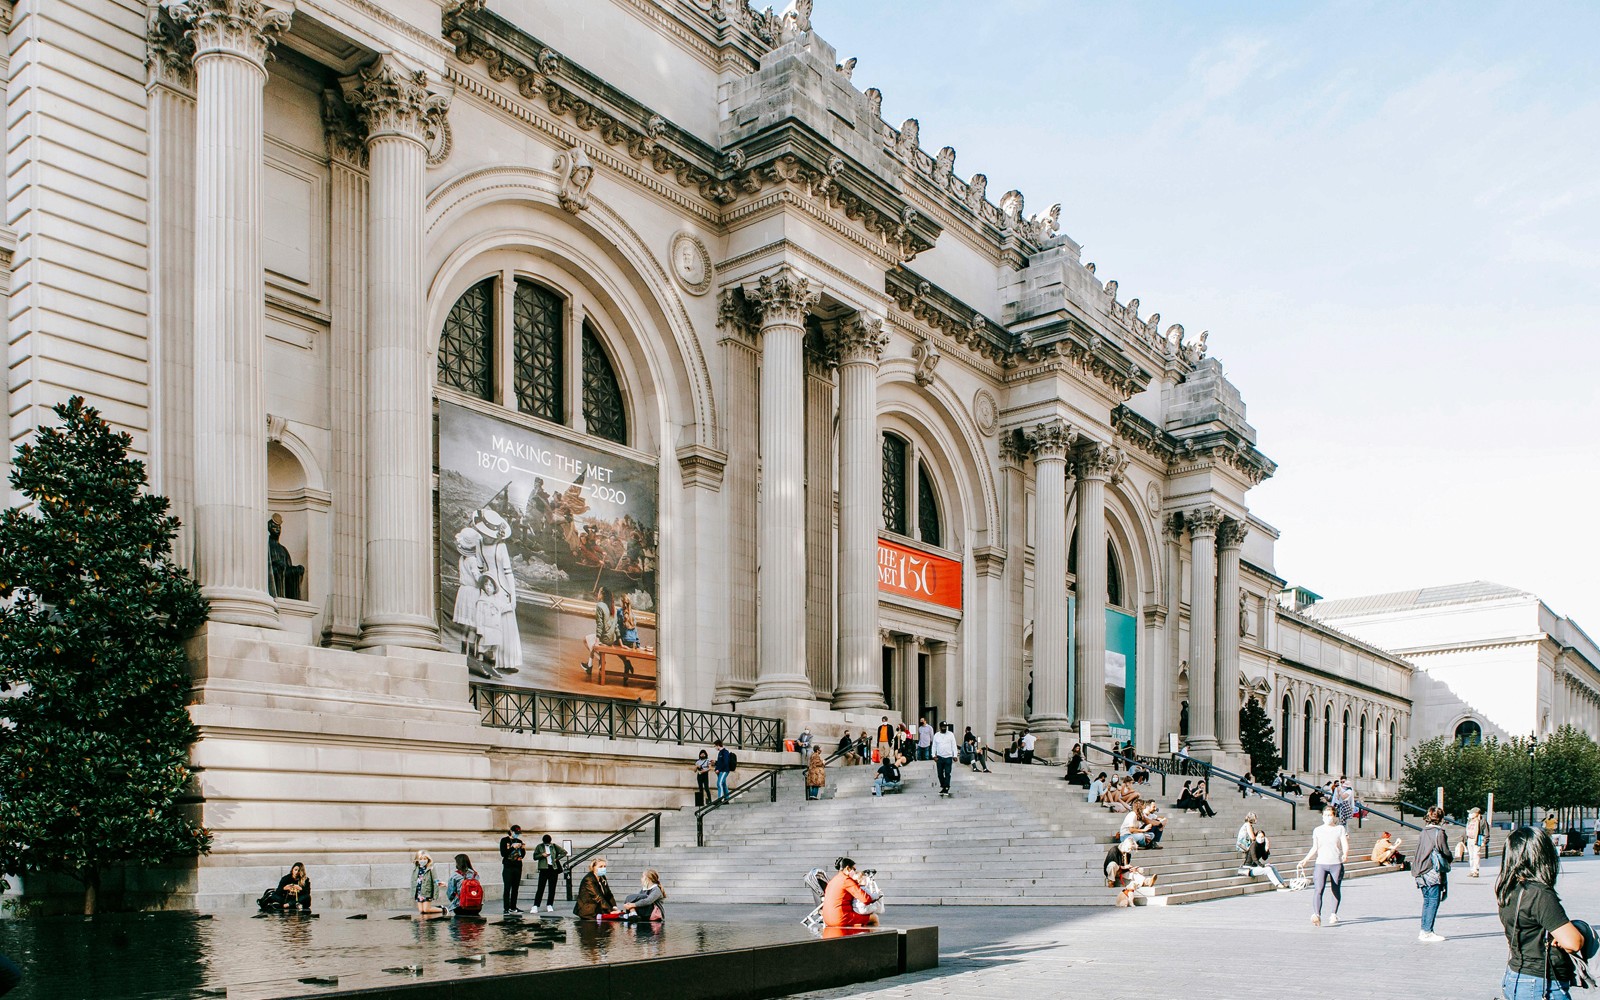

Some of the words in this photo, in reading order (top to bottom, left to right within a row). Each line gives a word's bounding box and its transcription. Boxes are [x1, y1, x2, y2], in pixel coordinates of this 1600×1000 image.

[476, 450, 510, 473] 1870
[591, 483, 626, 505] 2020
[492, 434, 551, 467] MAKING
[555, 454, 582, 476] THE
[586, 463, 613, 483] MET
[878, 546, 898, 568] THE
[898, 554, 937, 596] 150
